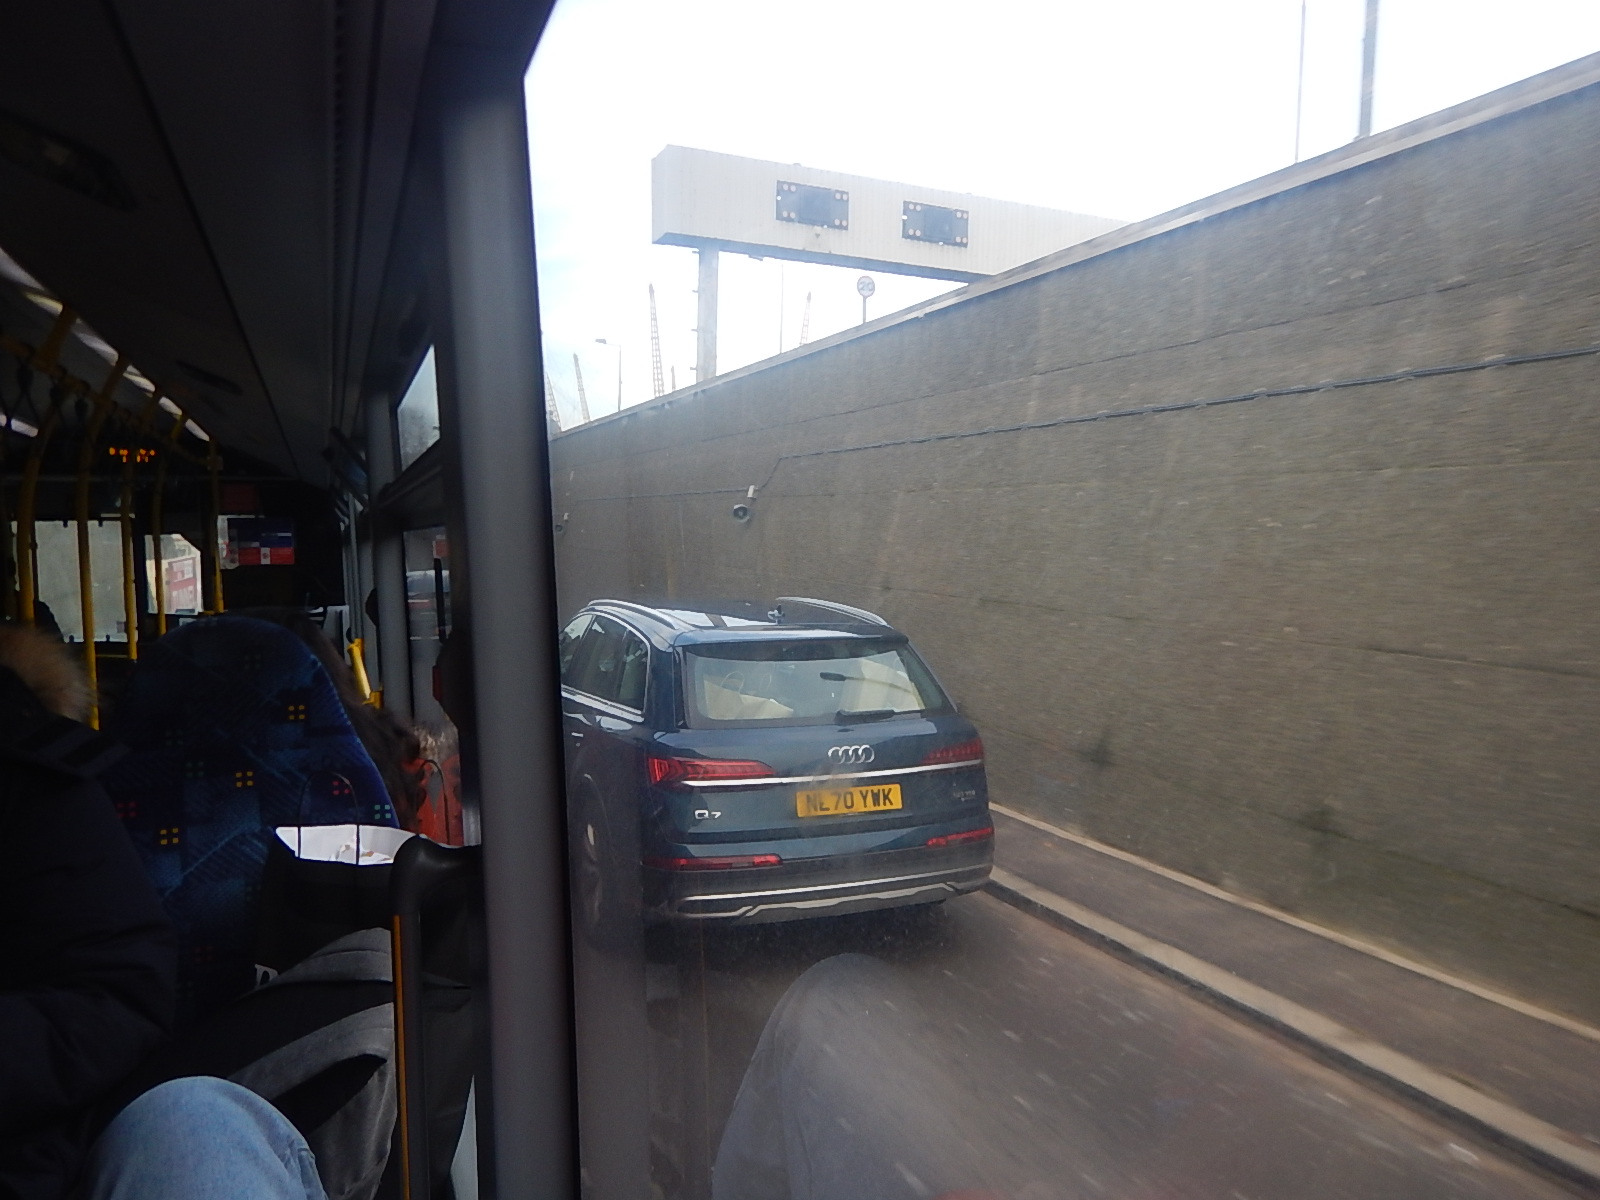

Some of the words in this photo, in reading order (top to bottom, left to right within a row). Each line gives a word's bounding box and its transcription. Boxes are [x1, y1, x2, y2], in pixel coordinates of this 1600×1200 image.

[806, 791, 854, 813] NL70
[860, 787, 893, 809] YWK
[695, 809, 722, 820] Q7
